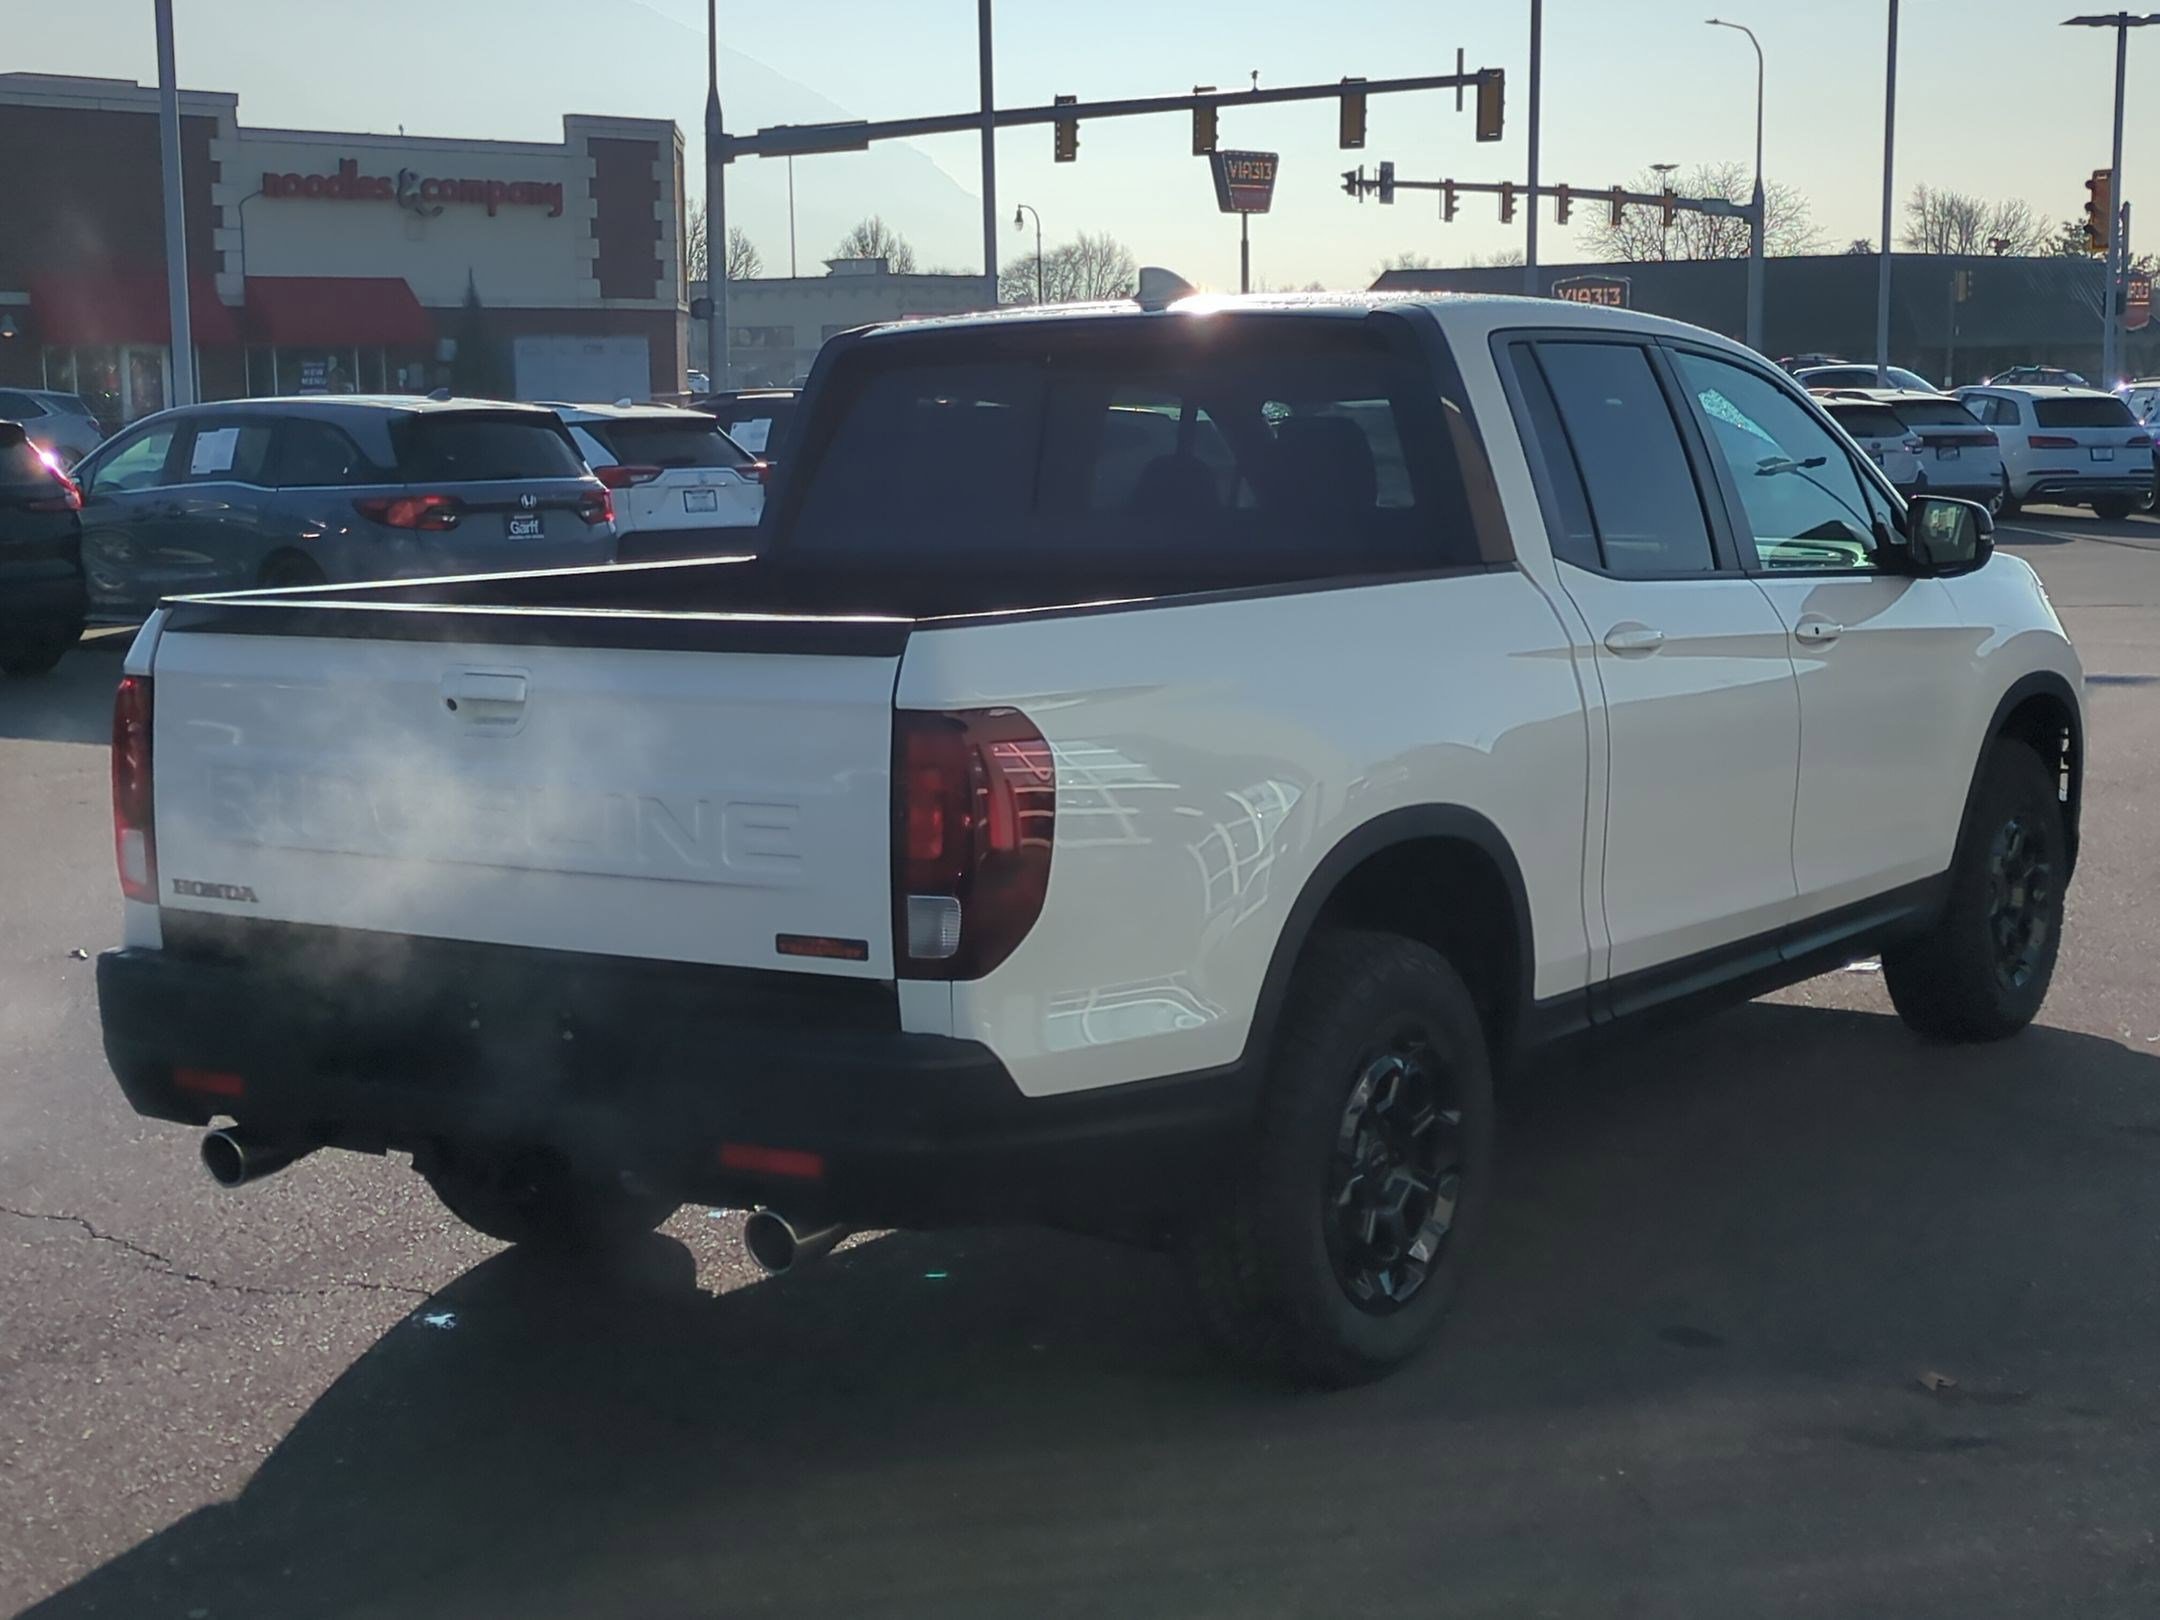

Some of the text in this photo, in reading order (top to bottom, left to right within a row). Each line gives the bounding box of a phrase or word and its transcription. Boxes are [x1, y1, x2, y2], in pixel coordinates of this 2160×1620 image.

[262, 158, 394, 199] noodles
[420, 177, 564, 218] company
[172, 878, 259, 903] HONDA
